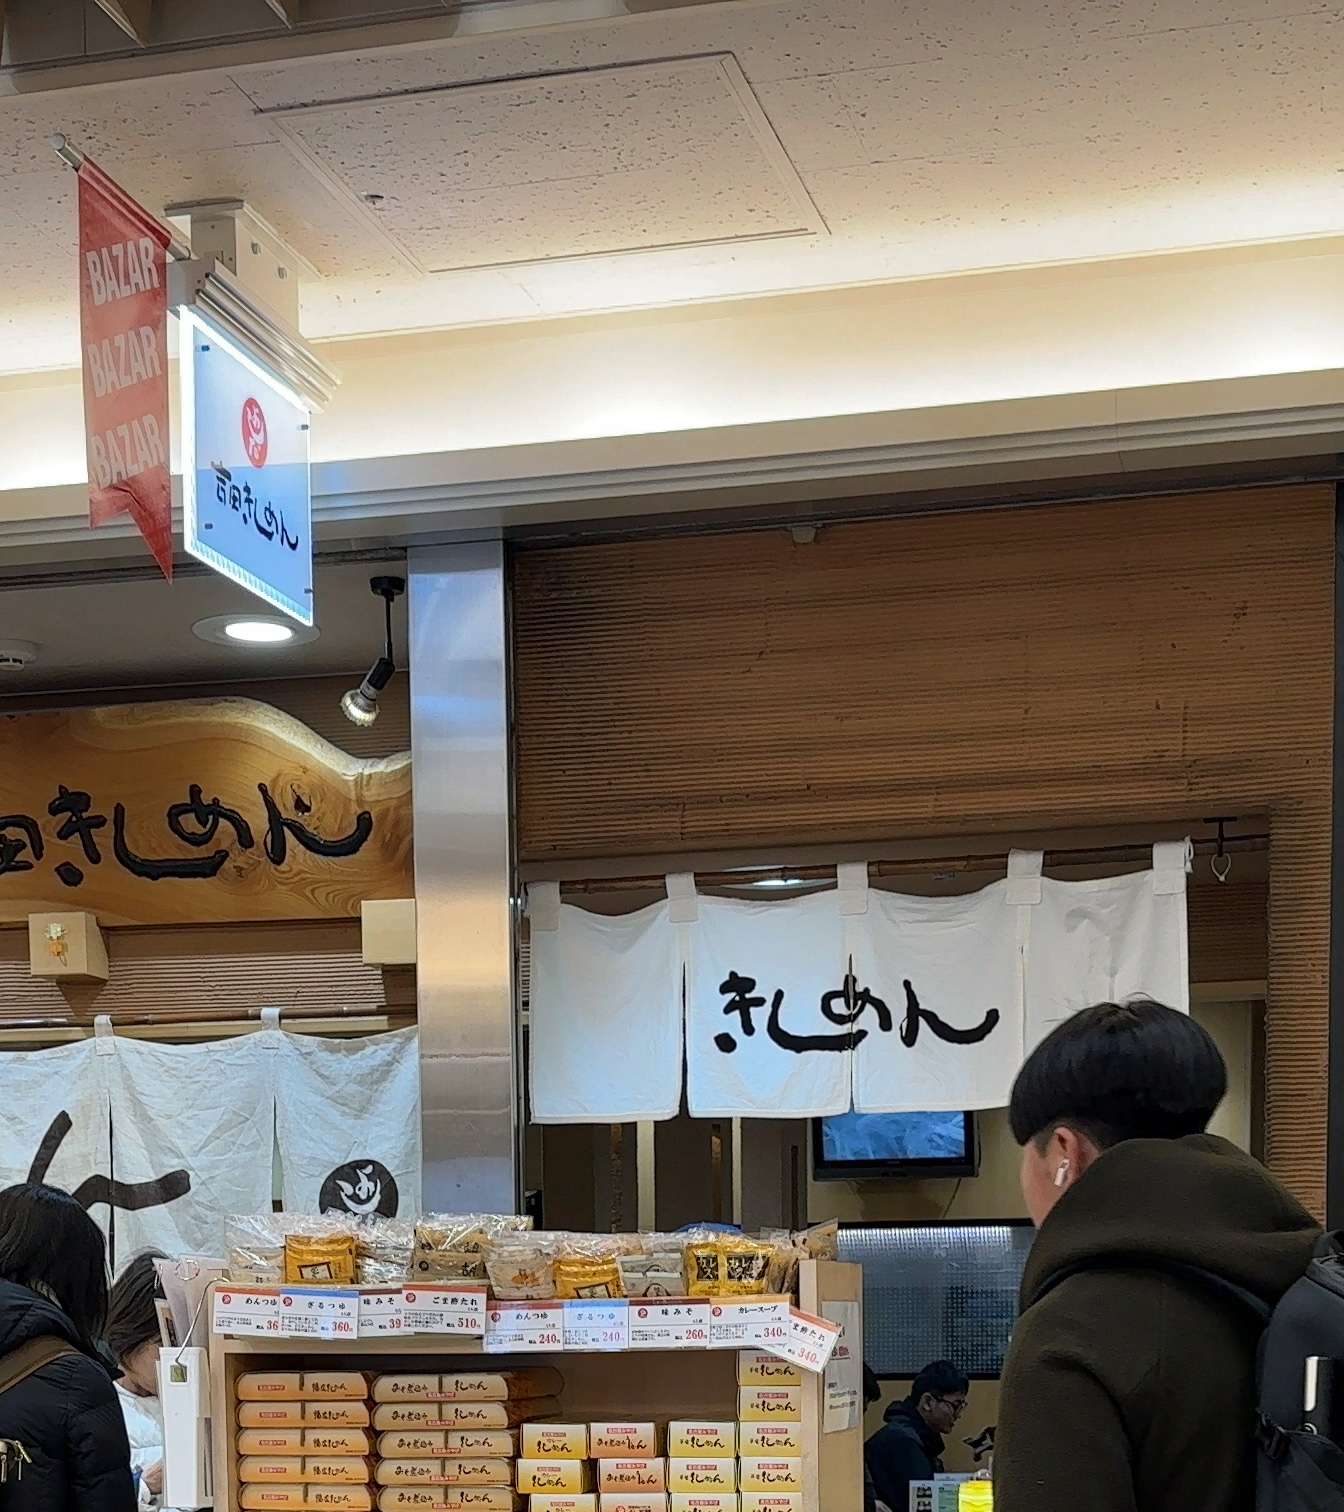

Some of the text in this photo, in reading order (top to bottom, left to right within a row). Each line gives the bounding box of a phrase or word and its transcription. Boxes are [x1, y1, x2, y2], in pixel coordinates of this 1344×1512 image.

[86, 236, 160, 306] BAZAR
[87, 325, 162, 398] BAZAR
[90, 413, 166, 489] BAZAR
[211, 460, 299, 551] 吉田きしめん
[714, 970, 1000, 1053] きしめん
